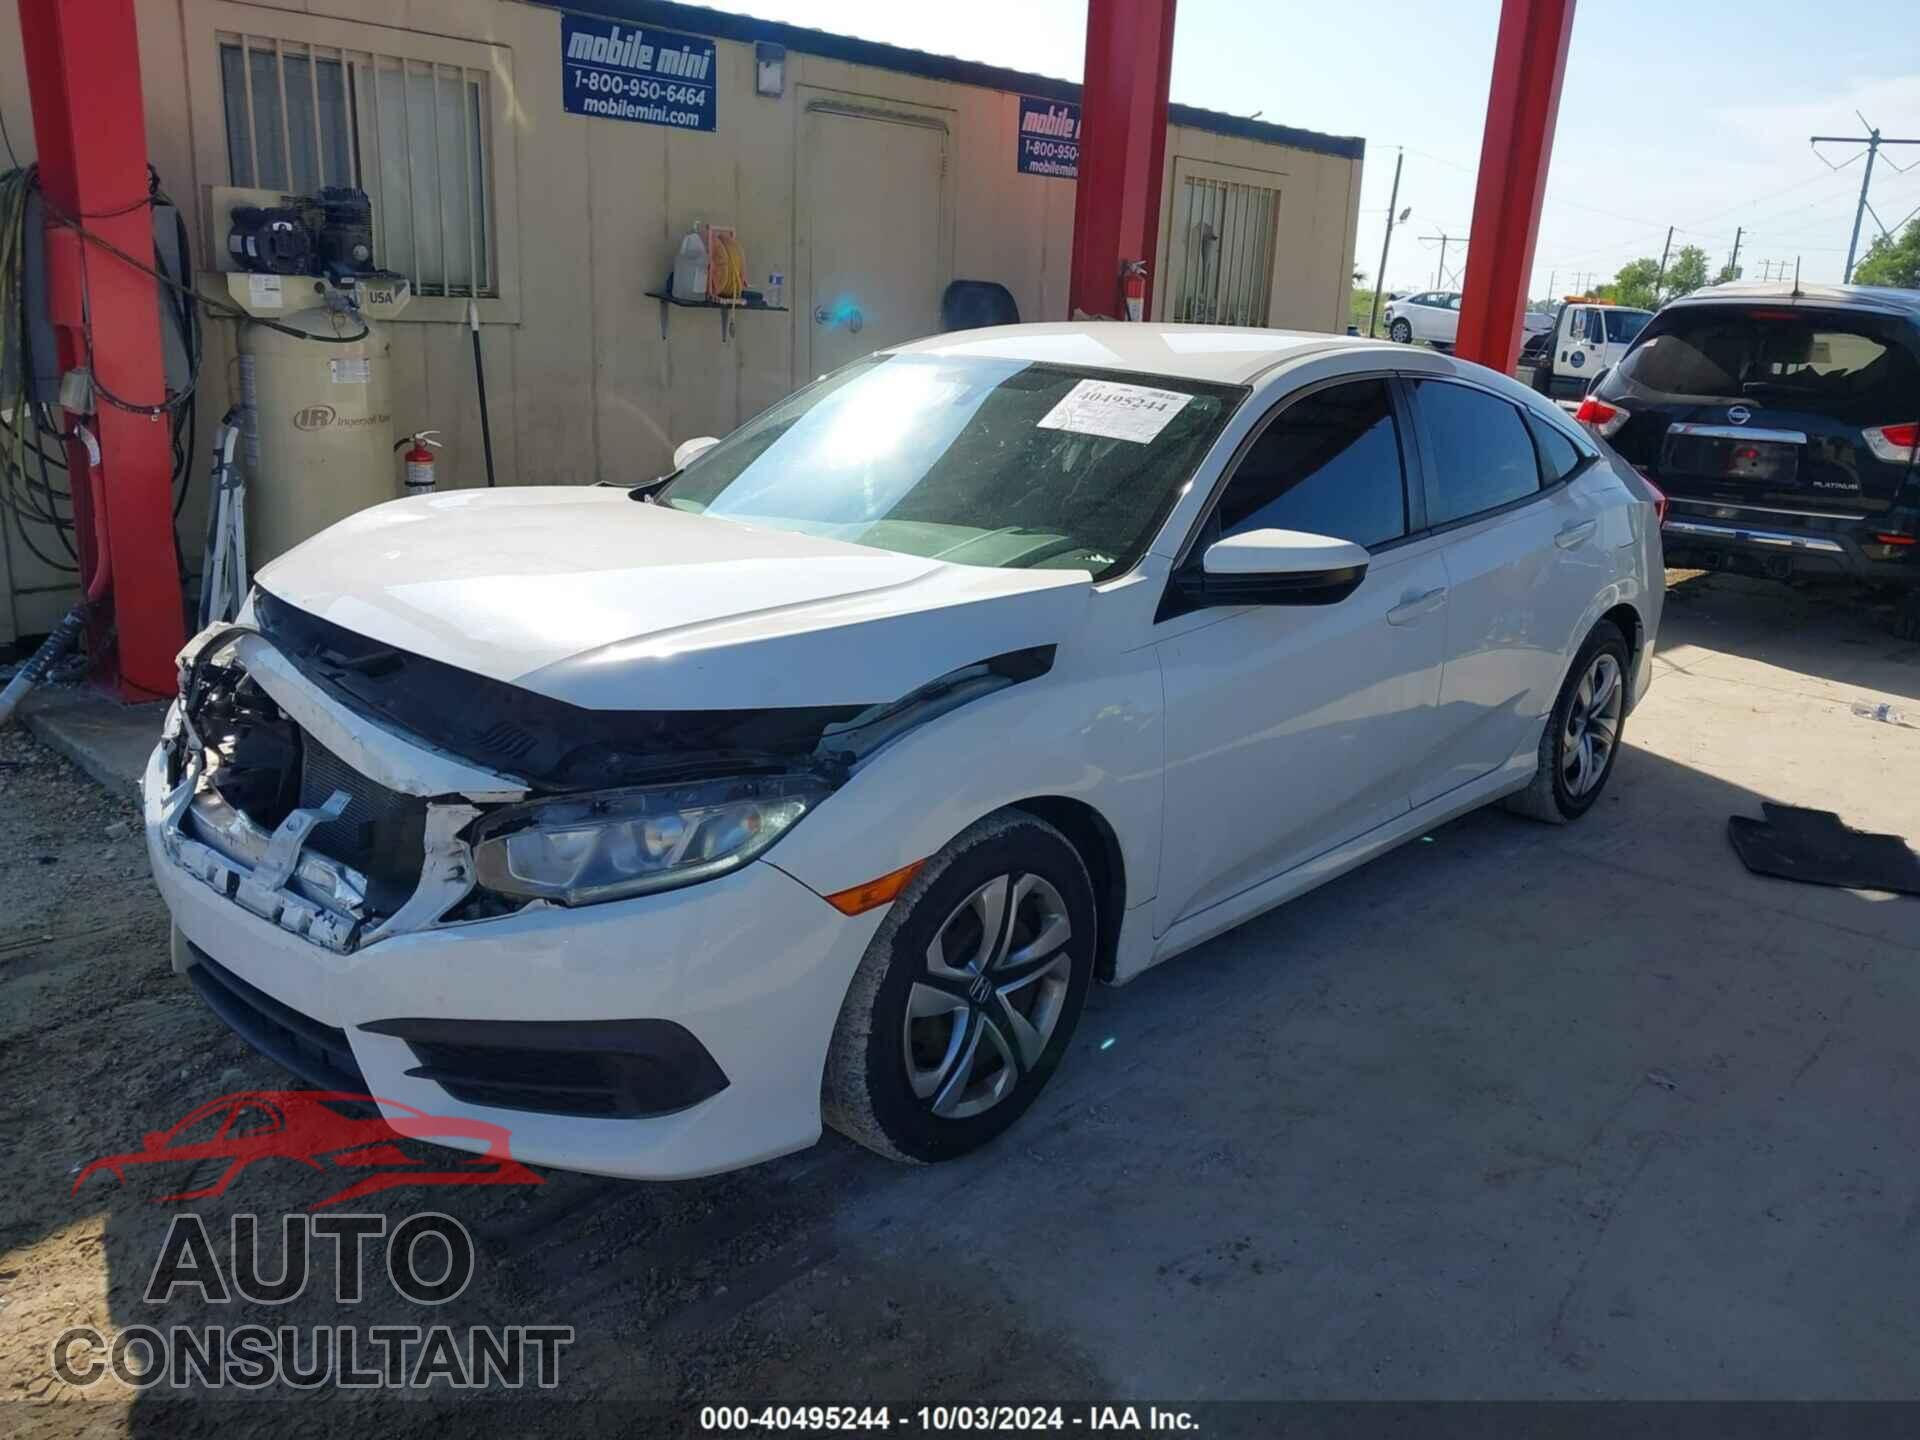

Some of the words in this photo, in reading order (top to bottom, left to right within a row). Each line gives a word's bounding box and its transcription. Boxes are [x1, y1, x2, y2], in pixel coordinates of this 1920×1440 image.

[567, 25, 654, 71] mobile
[655, 45, 711, 80] mini
[575, 70, 706, 107] 1-800-950-6464
[583, 98, 699, 127] mobilemini.com
[1022, 105, 1074, 137] mobile
[1025, 139, 1080, 160] 1-800-950-
[1029, 160, 1079, 177] mobilemin
[369, 291, 393, 304] USA
[1080, 391, 1168, 412] 40495244
[1813, 480, 1859, 490] PLATINUM
